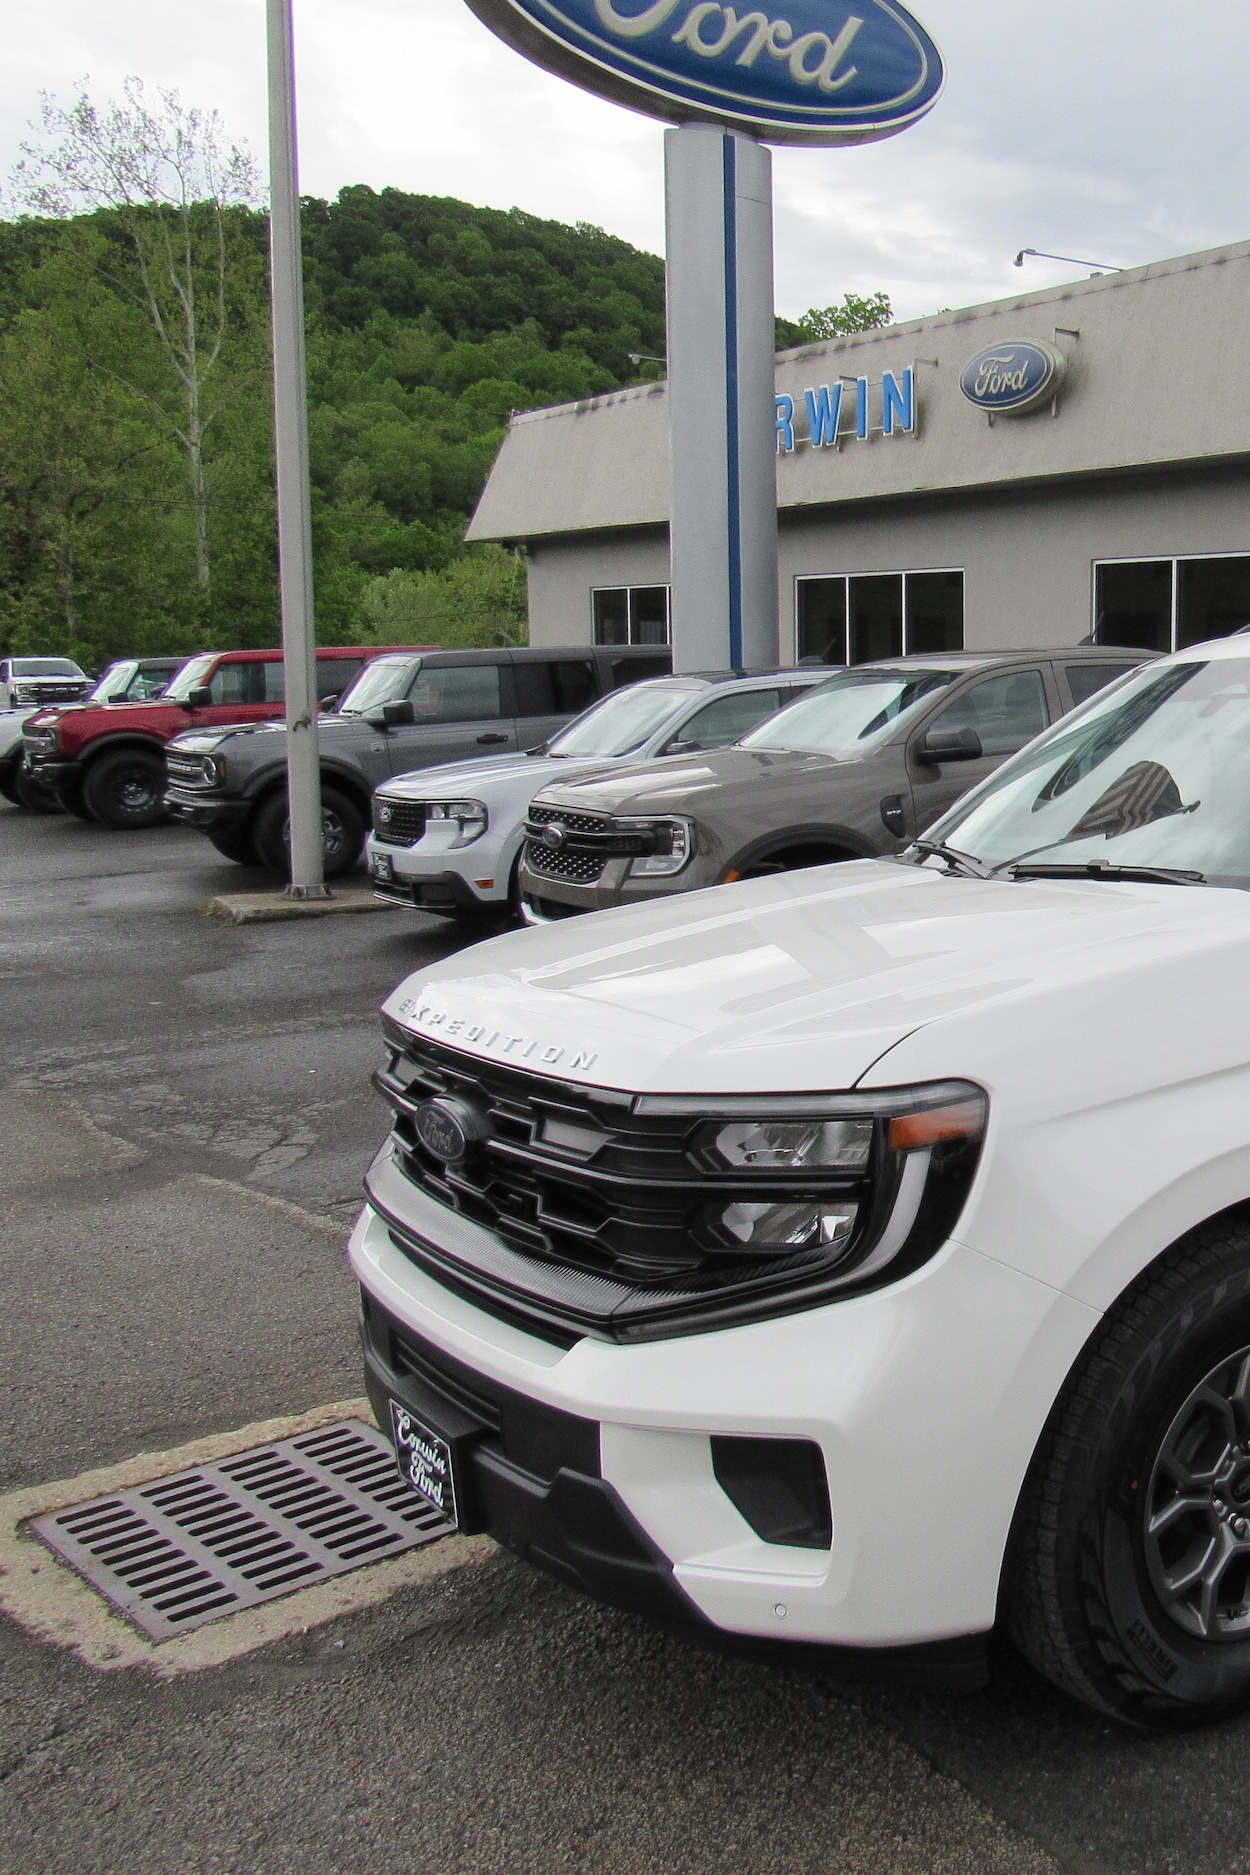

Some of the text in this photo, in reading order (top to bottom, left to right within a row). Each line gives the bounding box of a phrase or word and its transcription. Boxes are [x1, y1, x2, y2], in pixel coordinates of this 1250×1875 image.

[974, 354, 1029, 397] Ford
[399, 998, 598, 1070] EXPEDITION
[424, 1109, 455, 1154] Ford
[398, 1415, 446, 1475] Corwin
[410, 1451, 444, 1508] Ford
